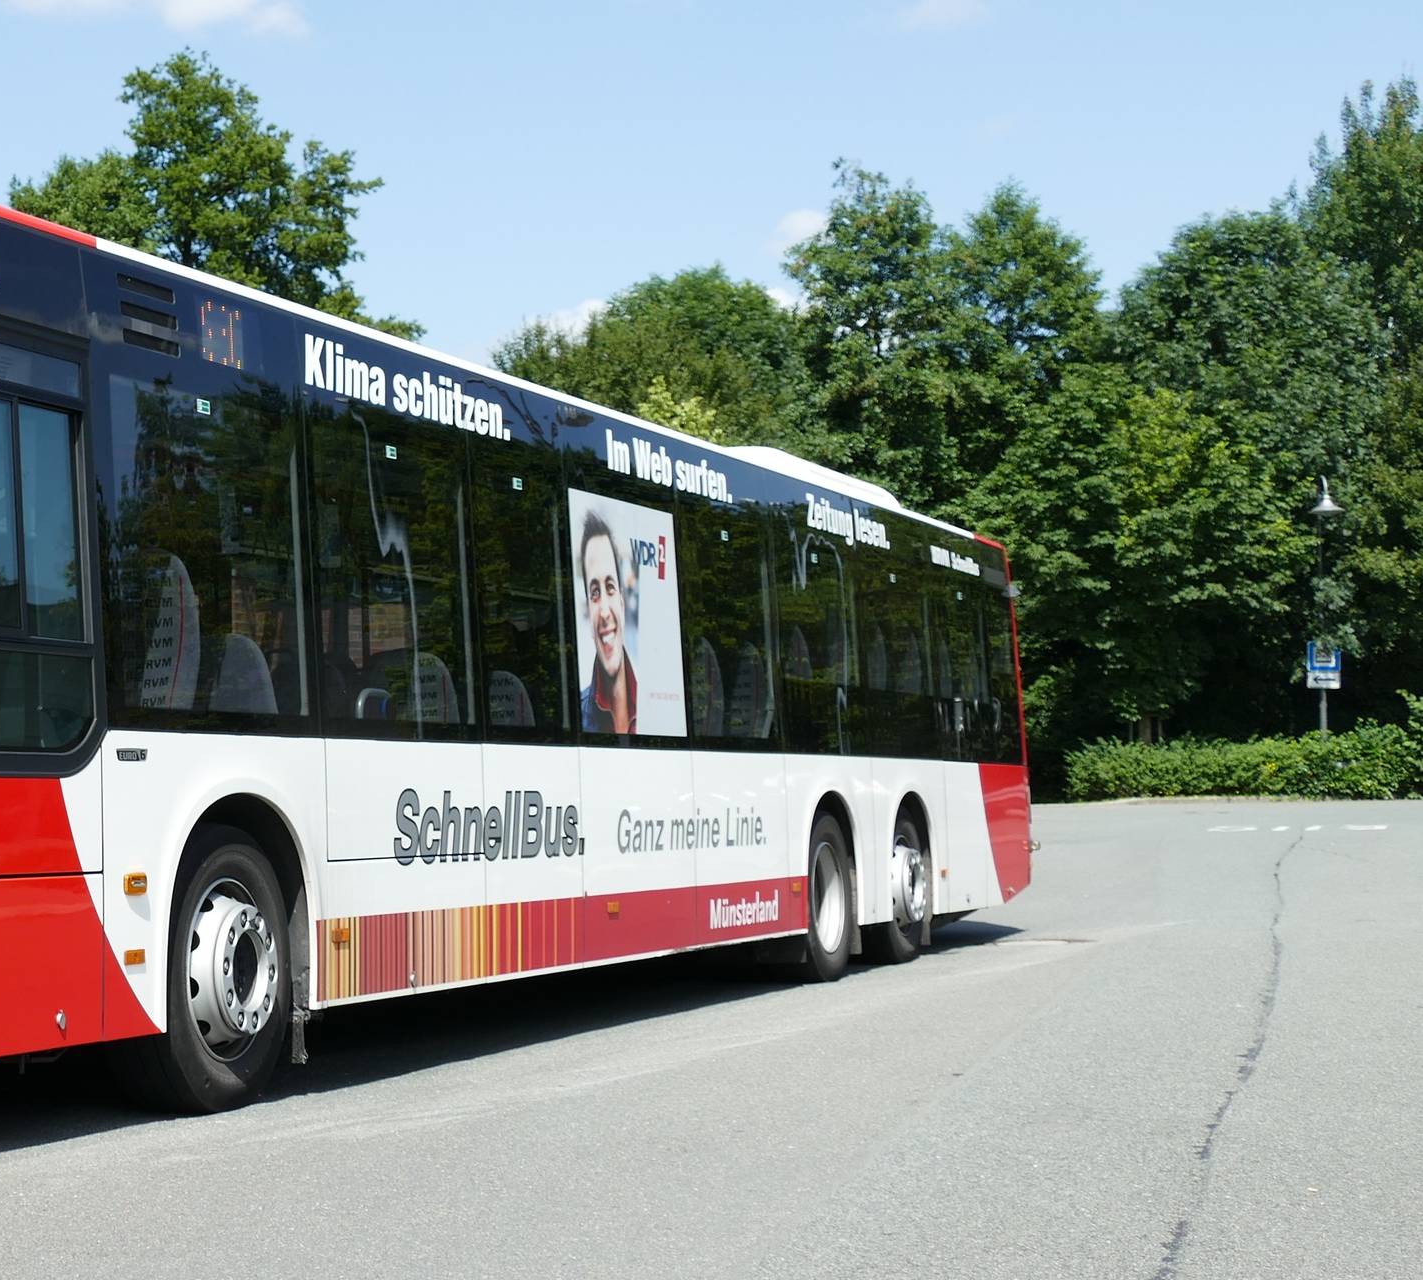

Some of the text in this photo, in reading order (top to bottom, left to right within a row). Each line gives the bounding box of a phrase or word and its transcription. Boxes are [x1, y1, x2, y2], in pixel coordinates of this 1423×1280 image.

[305, 333, 385, 406] Klima
[392, 371, 512, 441] schützen.
[605, 429, 733, 504] Im Web surfen.
[805, 493, 891, 550] Zeitung lesen.
[629, 537, 666, 569] WDR 2
[118, 750, 146, 761] EURO 6
[393, 788, 585, 867] SchnellBus.
[617, 807, 767, 854] Ganz meine Linie.
[709, 890, 779, 930] Münsterland
